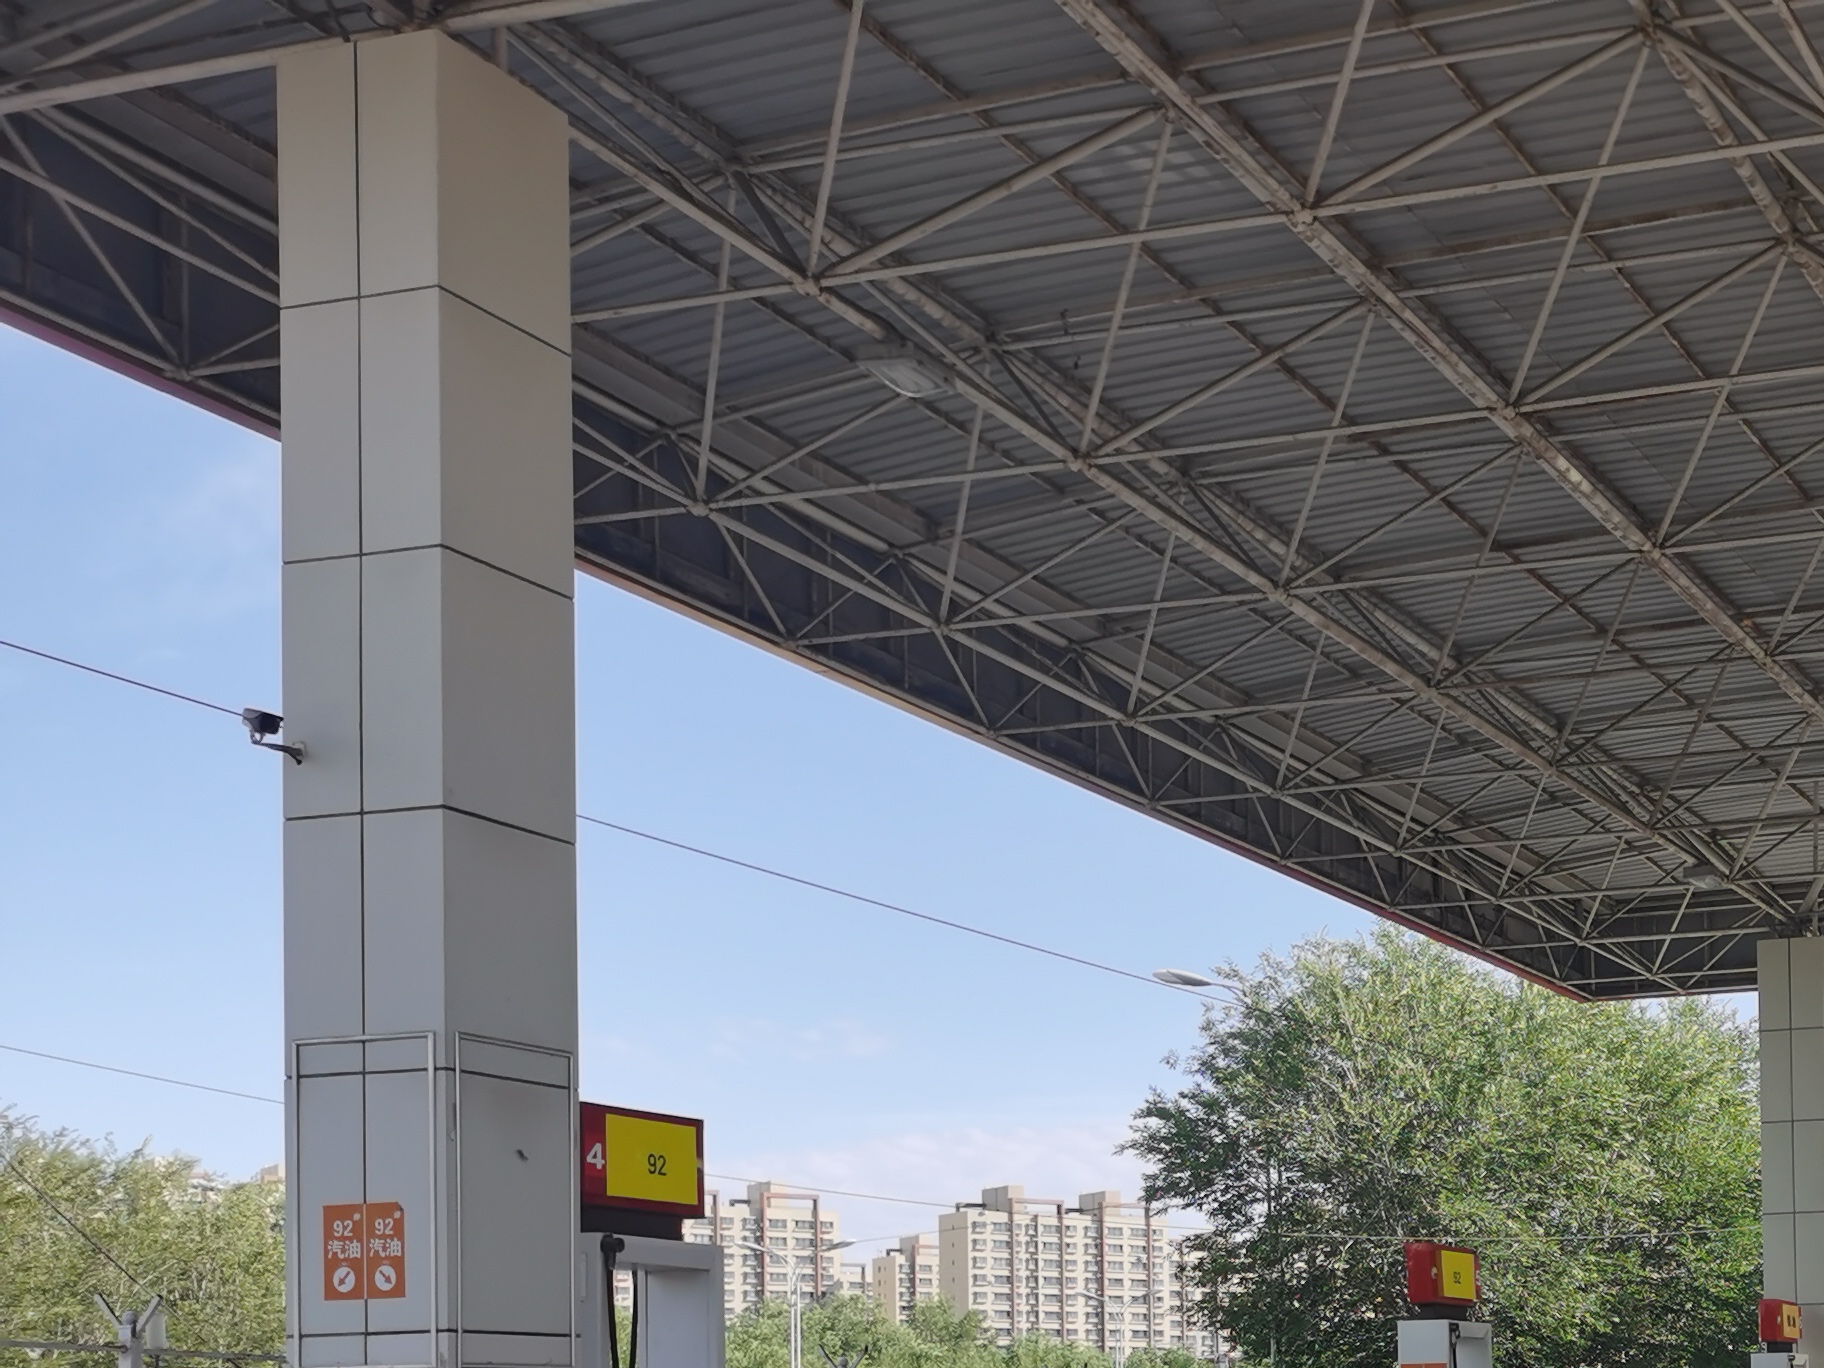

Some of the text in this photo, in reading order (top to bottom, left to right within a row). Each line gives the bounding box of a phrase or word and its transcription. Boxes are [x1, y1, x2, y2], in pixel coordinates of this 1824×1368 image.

[586, 1142, 605, 1170] 4
[647, 1153, 668, 1177] 92
[327, 1239, 361, 1260] 汽油
[369, 1237, 402, 1258] 汽油
